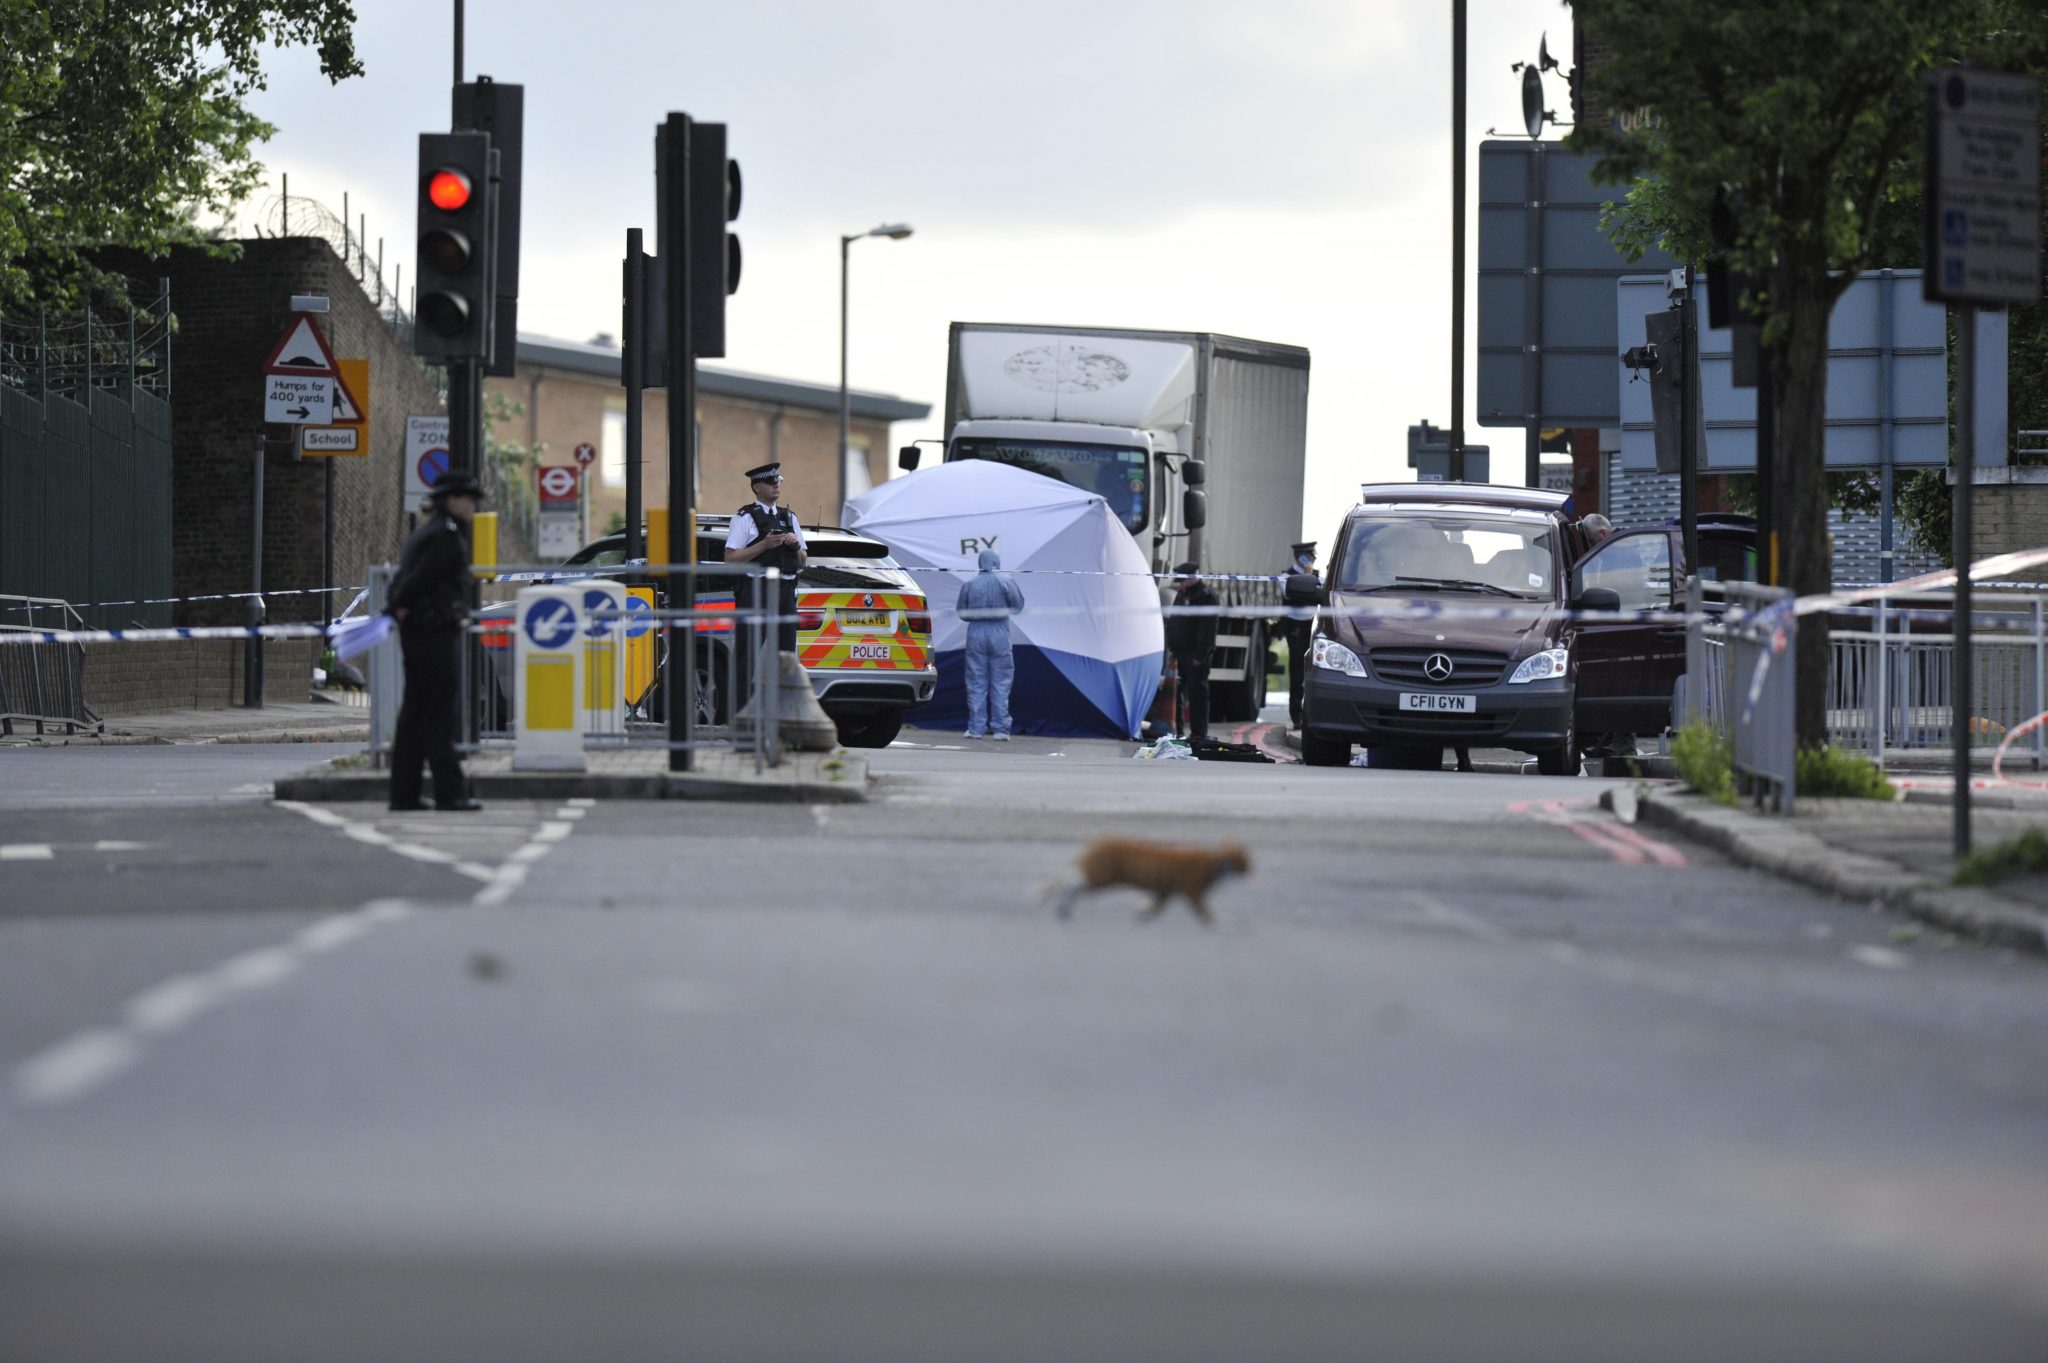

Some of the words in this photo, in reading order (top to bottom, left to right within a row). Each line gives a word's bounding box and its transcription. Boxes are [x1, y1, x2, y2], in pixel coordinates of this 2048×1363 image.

[274, 380, 308, 392] Humps
[311, 382, 326, 392] for
[269, 391, 295, 402] 400
[298, 393, 326, 404] yards
[309, 432, 353, 445] School
[418, 431, 450, 444] ZON
[995, 446, 1094, 464] VOLVO
[1545, 477, 1574, 490] ZON
[960, 535, 998, 555] RY
[852, 646, 889, 658] POLICE
[1410, 695, 1435, 708] CF11
[1438, 696, 1465, 709] GYN
